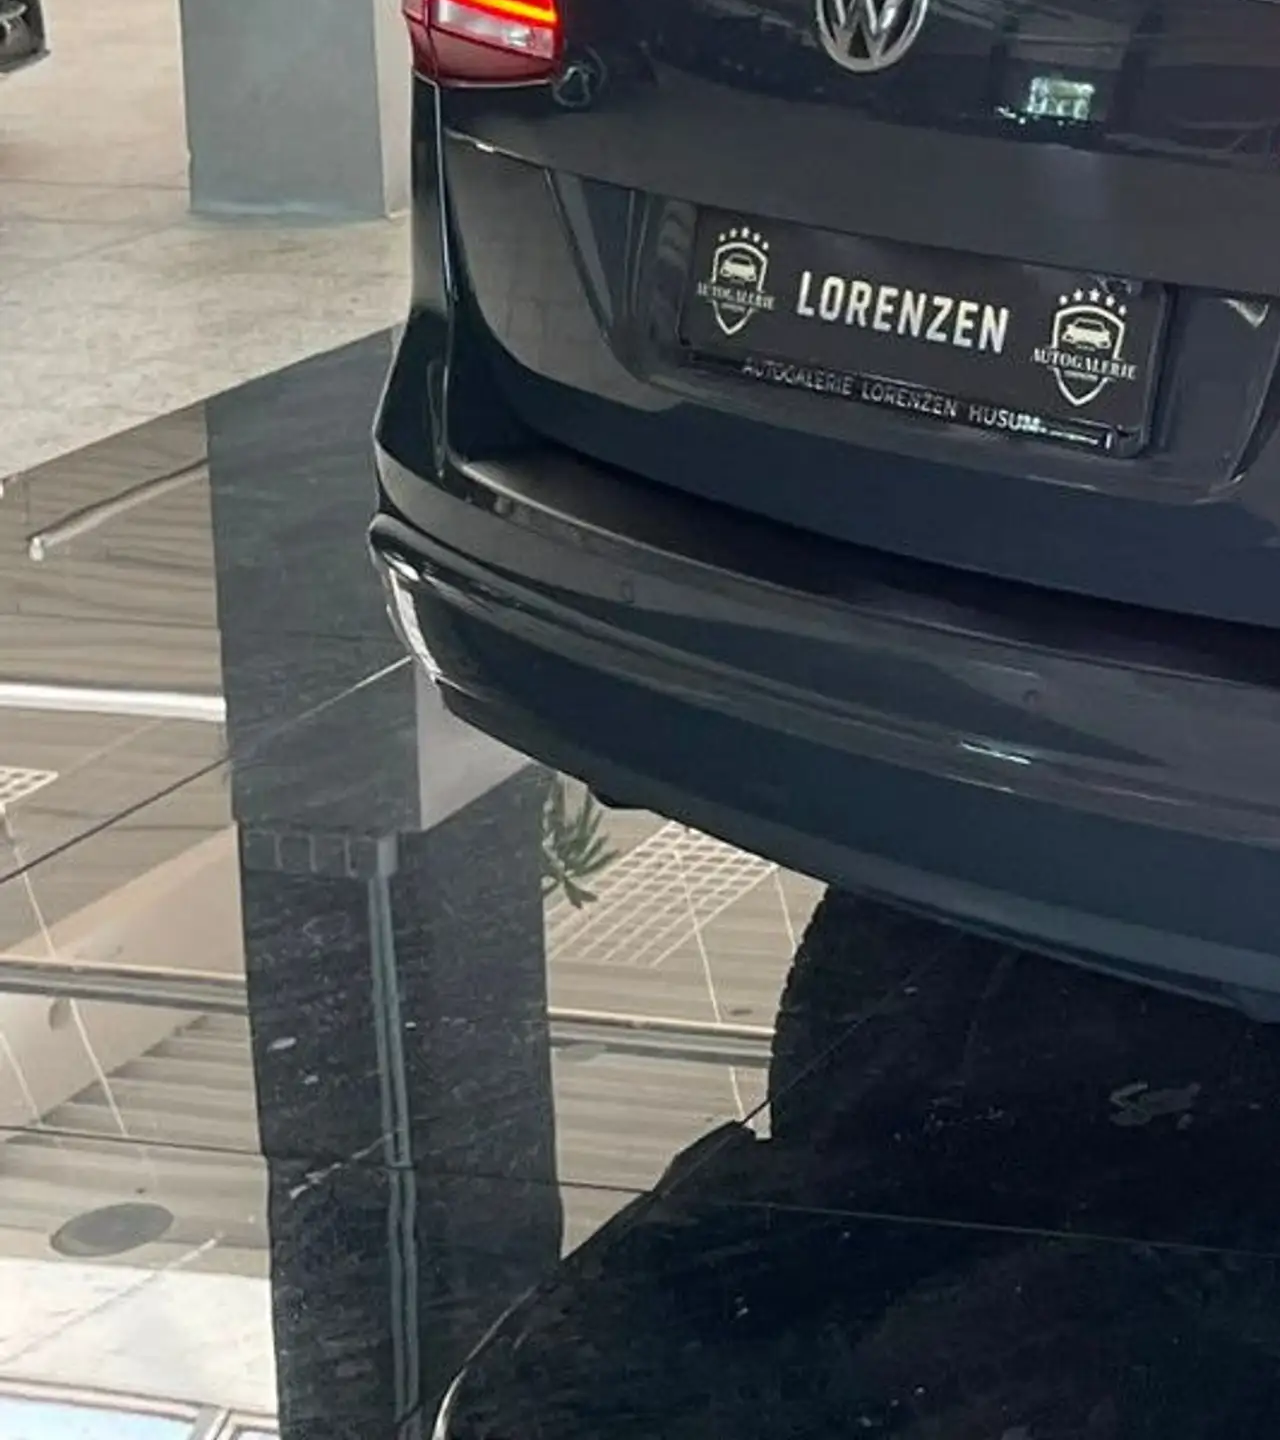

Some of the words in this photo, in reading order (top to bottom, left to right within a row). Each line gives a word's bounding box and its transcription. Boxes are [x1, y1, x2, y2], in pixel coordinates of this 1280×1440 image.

[797, 270, 1010, 355] LORENZEN
[741, 356, 854, 397] AUTOGALERIE
[861, 378, 958, 418] LORENZEN
[1030, 347, 1140, 381] AUTOGALERIE
